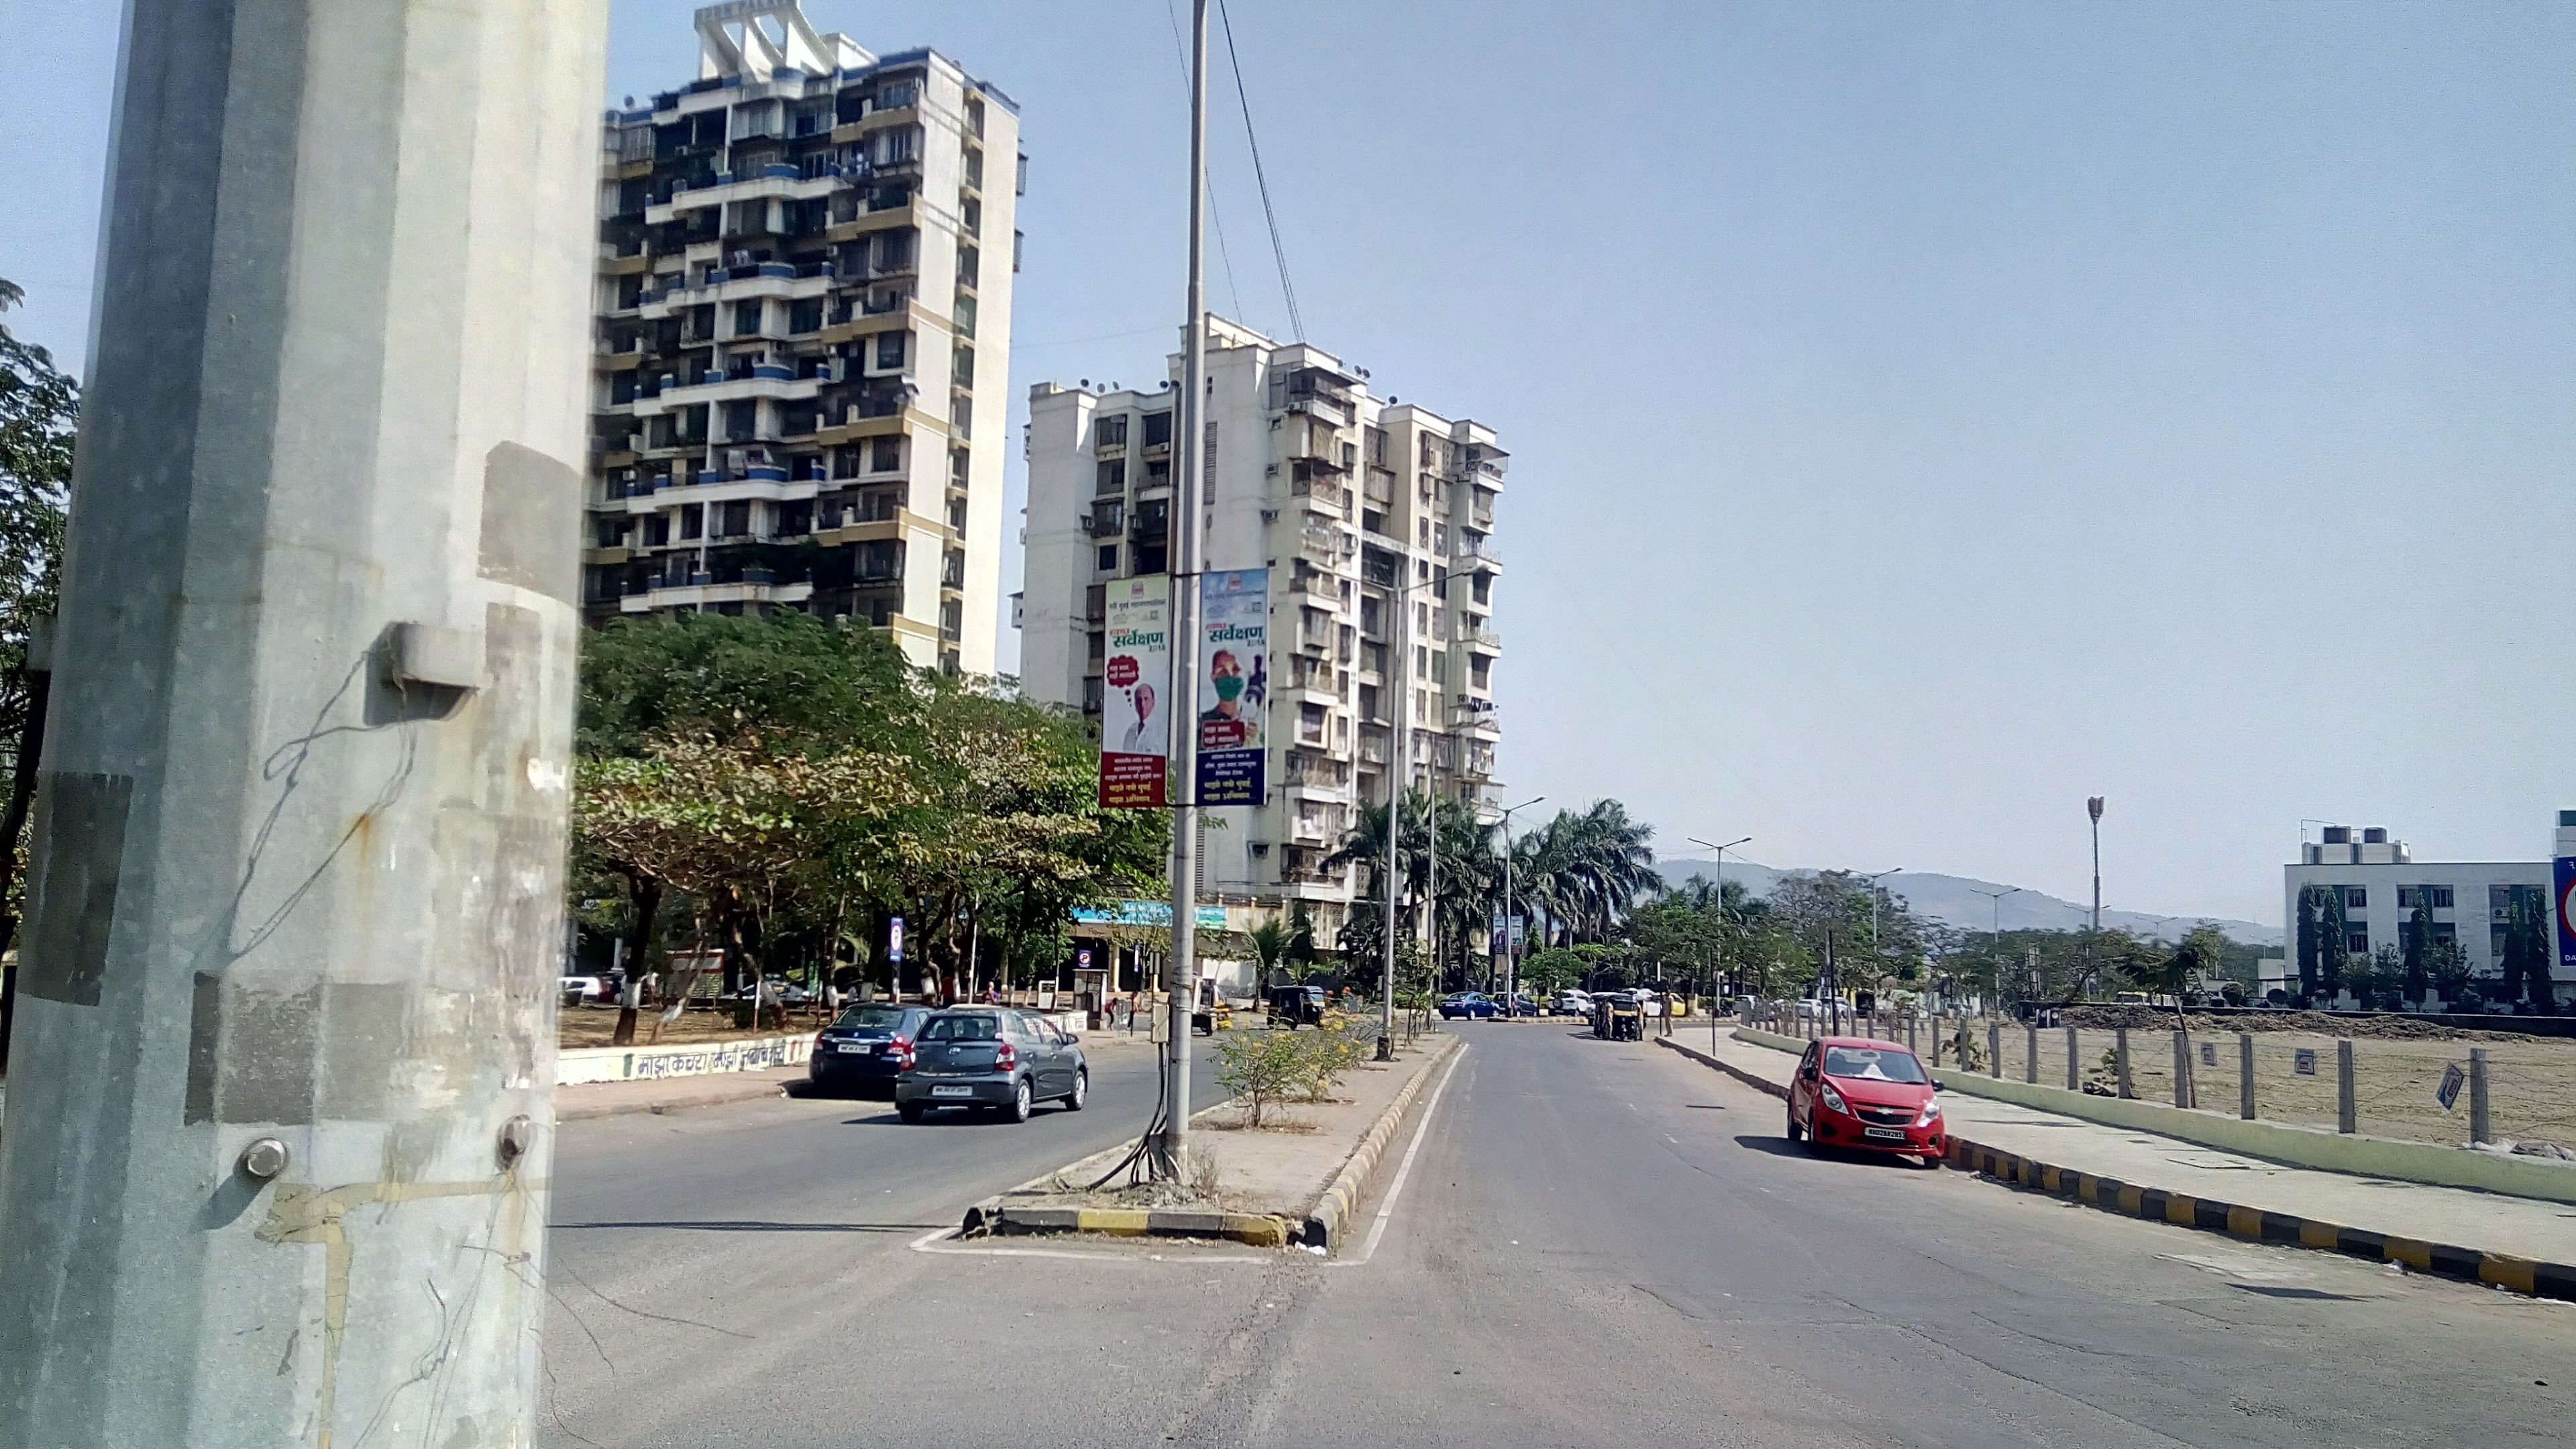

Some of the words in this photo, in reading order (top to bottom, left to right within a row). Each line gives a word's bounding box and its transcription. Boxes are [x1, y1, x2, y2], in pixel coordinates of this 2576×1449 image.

[1113, 629, 1164, 648] सर्वेक्षण
[638, 1055, 669, 1077] माझा
[671, 1053, 707, 1071] कचरा
